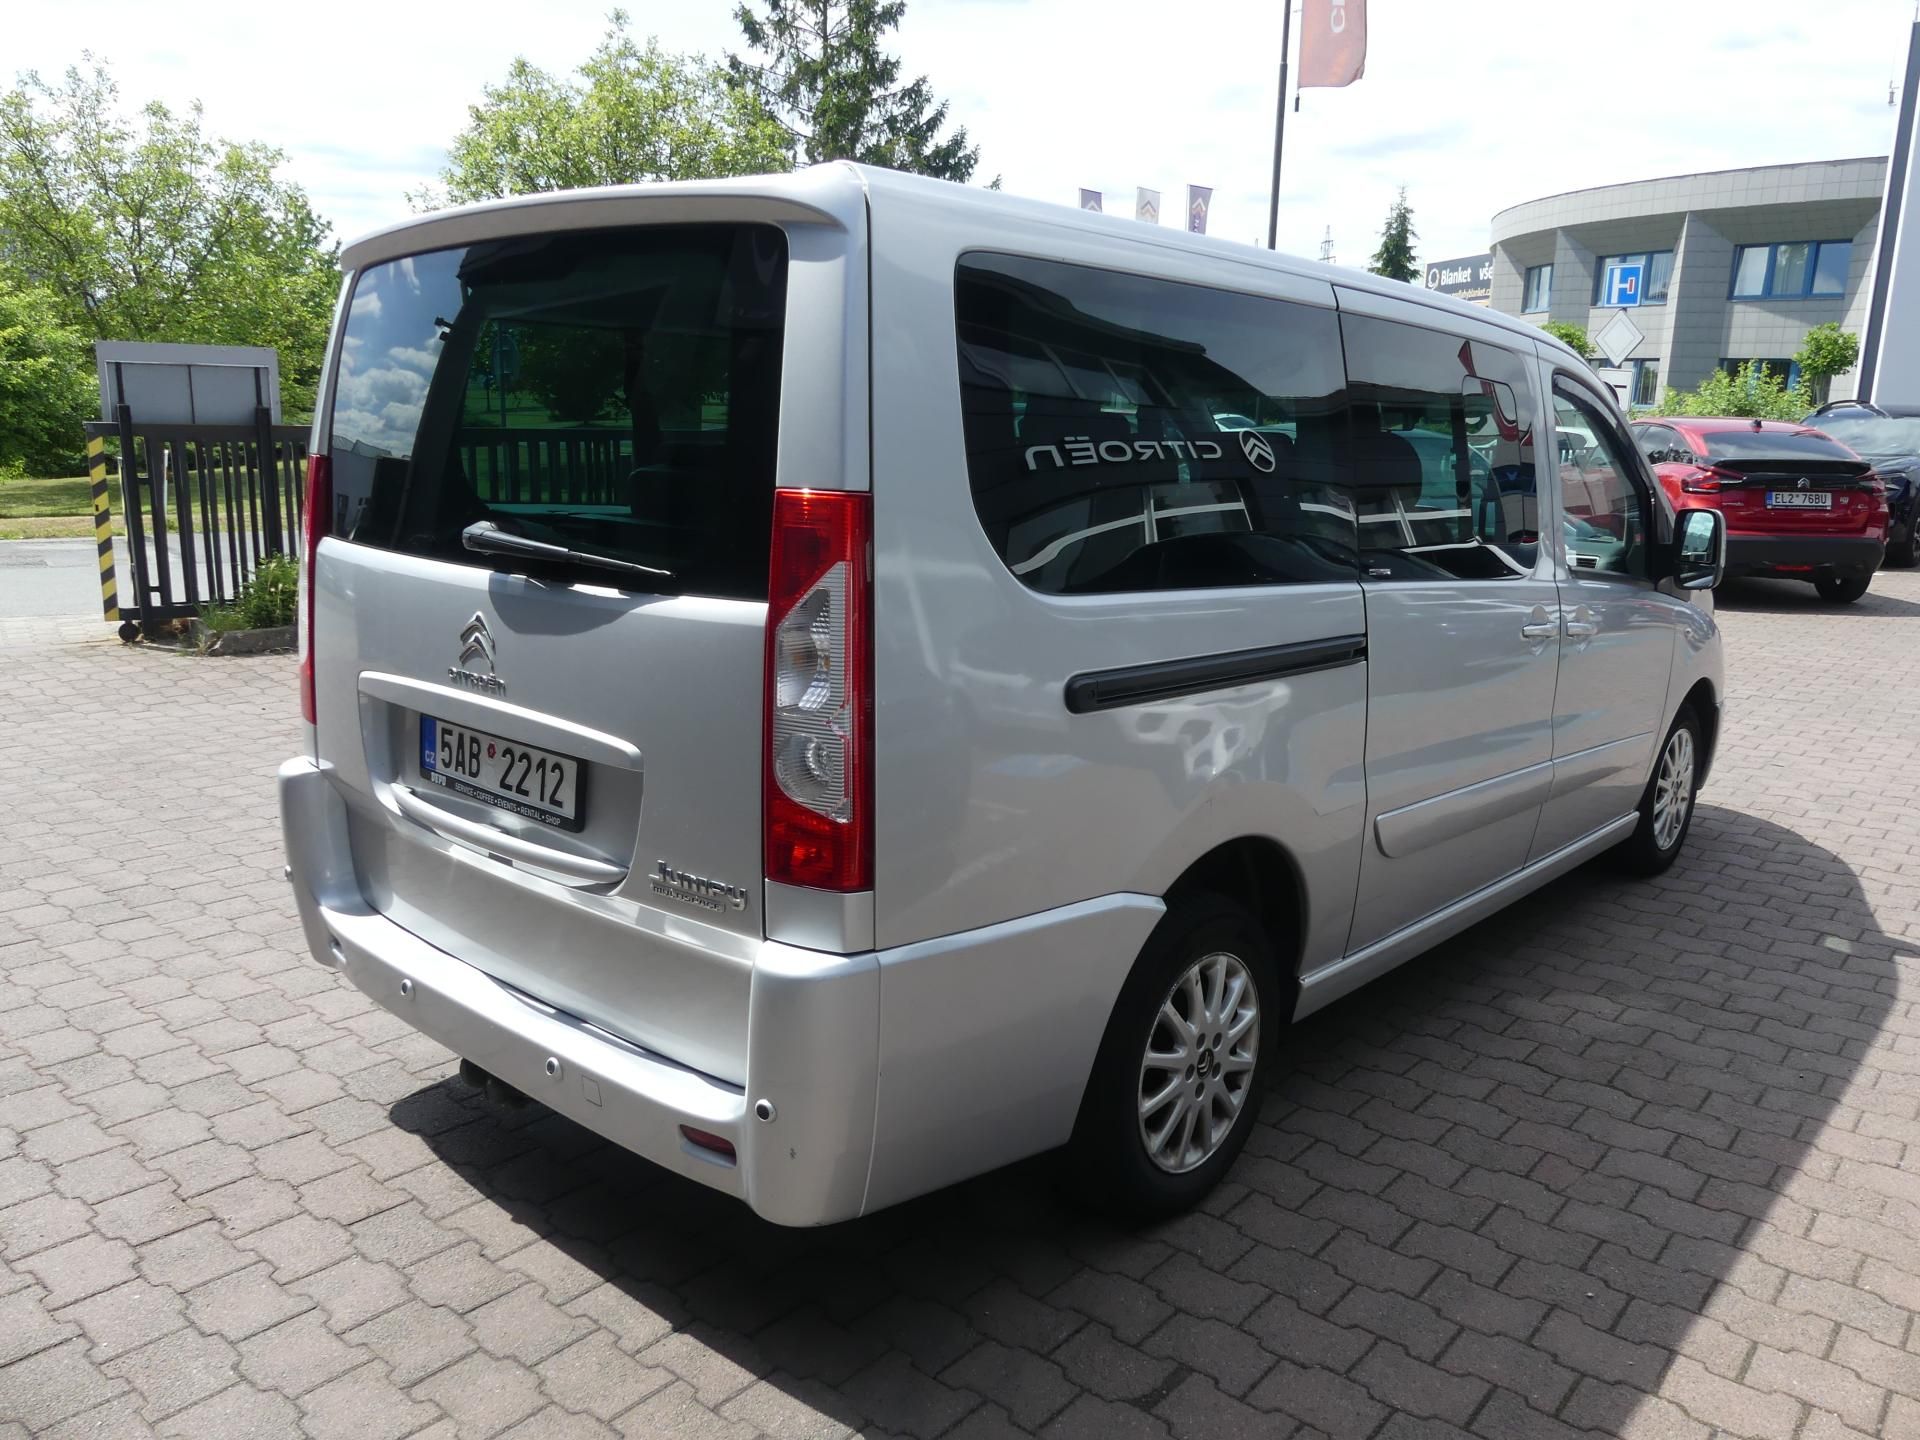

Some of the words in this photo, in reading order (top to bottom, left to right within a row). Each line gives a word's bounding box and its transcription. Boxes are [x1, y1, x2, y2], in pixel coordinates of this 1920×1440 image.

[1441, 266, 1472, 286] Blanket
[1774, 493, 1793, 504] EL2
[1802, 493, 1827, 505] 76BU
[425, 750, 435, 764] CZ
[440, 727, 481, 778] 5AB
[500, 747, 564, 808] 2212
[455, 782, 474, 797] SERVICE
[476, 791, 494, 805] COFFEE
[498, 799, 517, 812] EVENTS
[521, 806, 541, 820] RENTAL
[546, 814, 561, 826] SHOP
